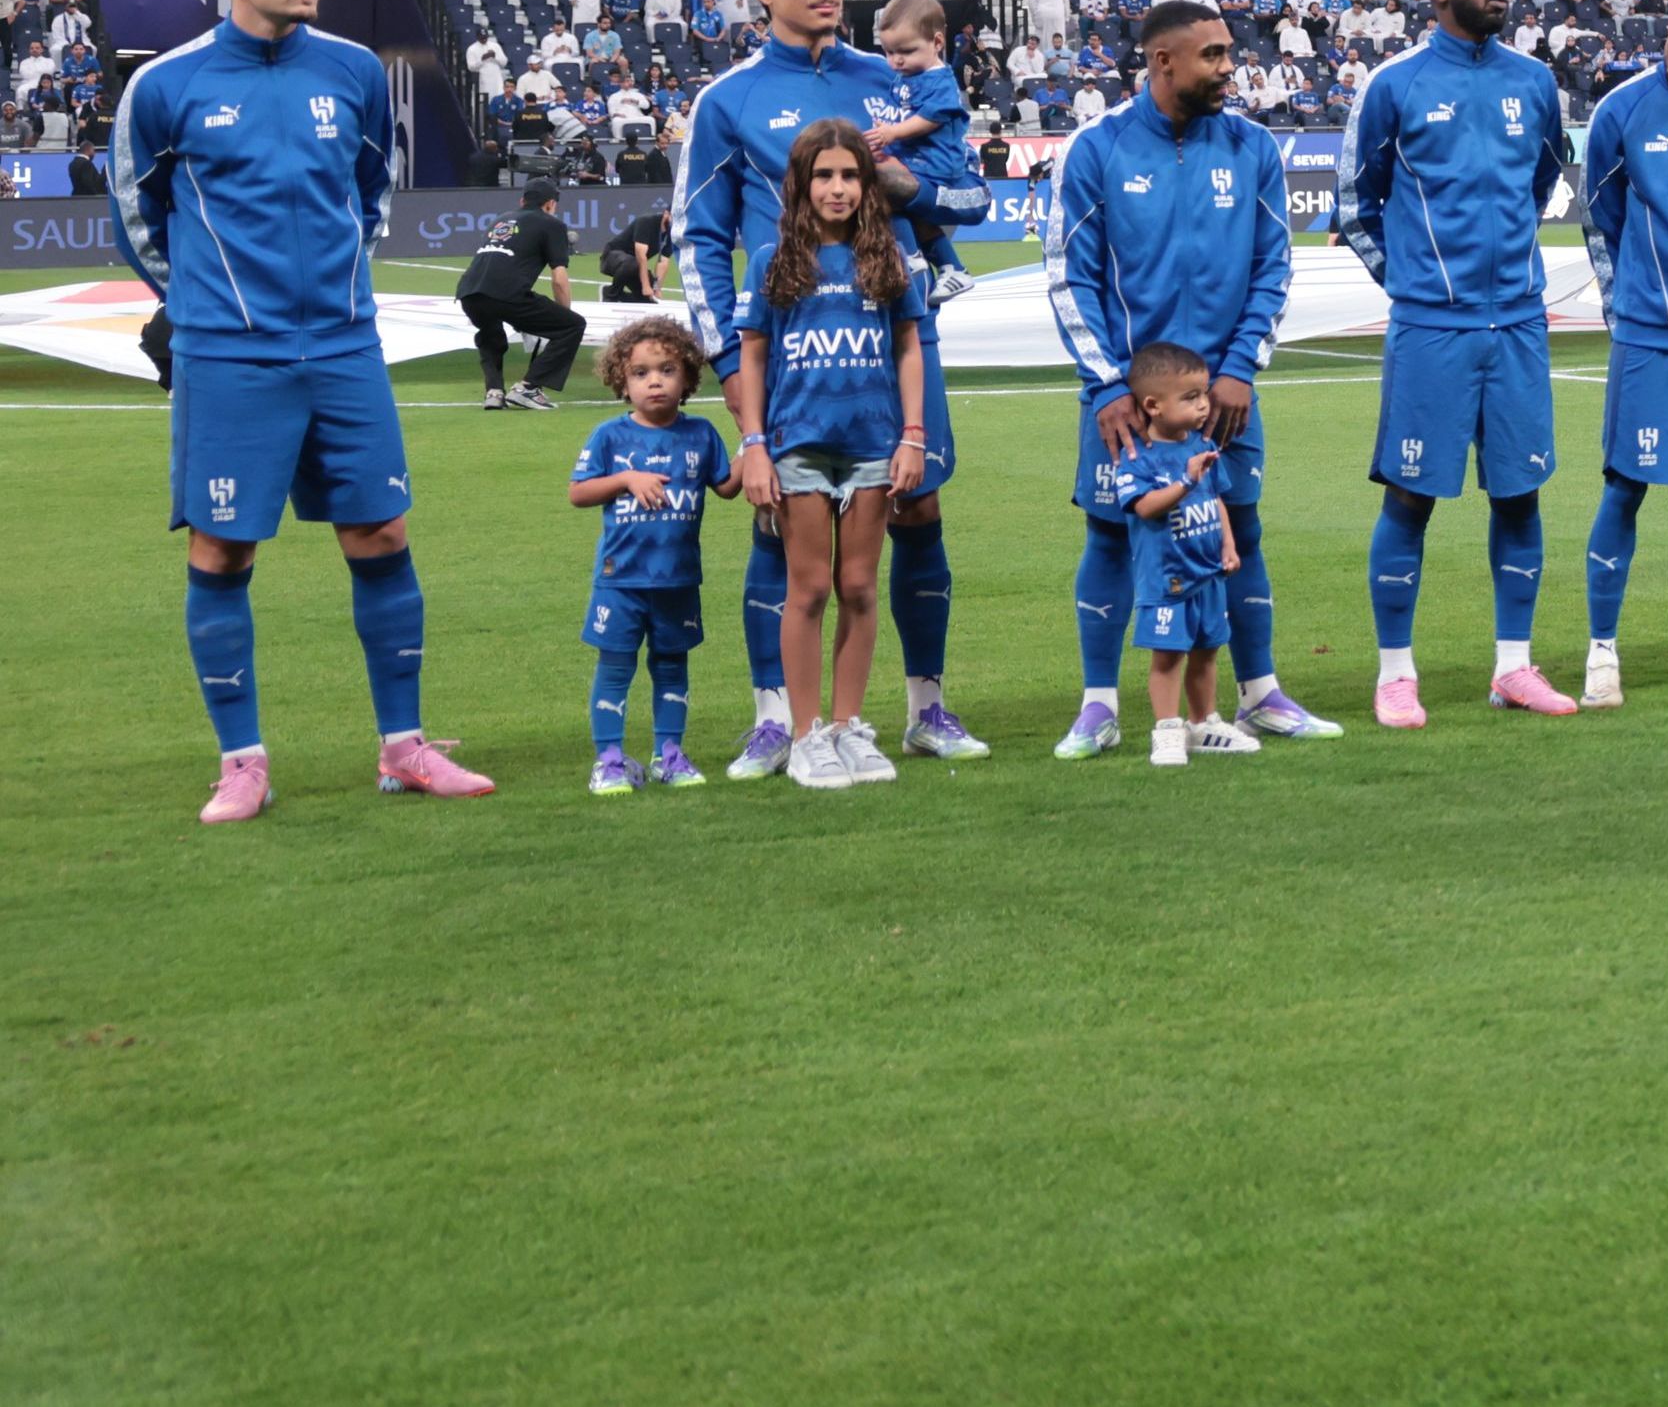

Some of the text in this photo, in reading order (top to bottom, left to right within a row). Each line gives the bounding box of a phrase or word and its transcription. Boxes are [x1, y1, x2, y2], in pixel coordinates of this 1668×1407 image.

[205, 114, 234, 129] KING
[769, 117, 796, 130] KING
[1426, 111, 1451, 123] KING
[1644, 142, 1668, 152] KING
[623, 153, 645, 161] POLICE
[1293, 154, 1335, 167] SEVEN
[783, 328, 884, 361] SAVVY
